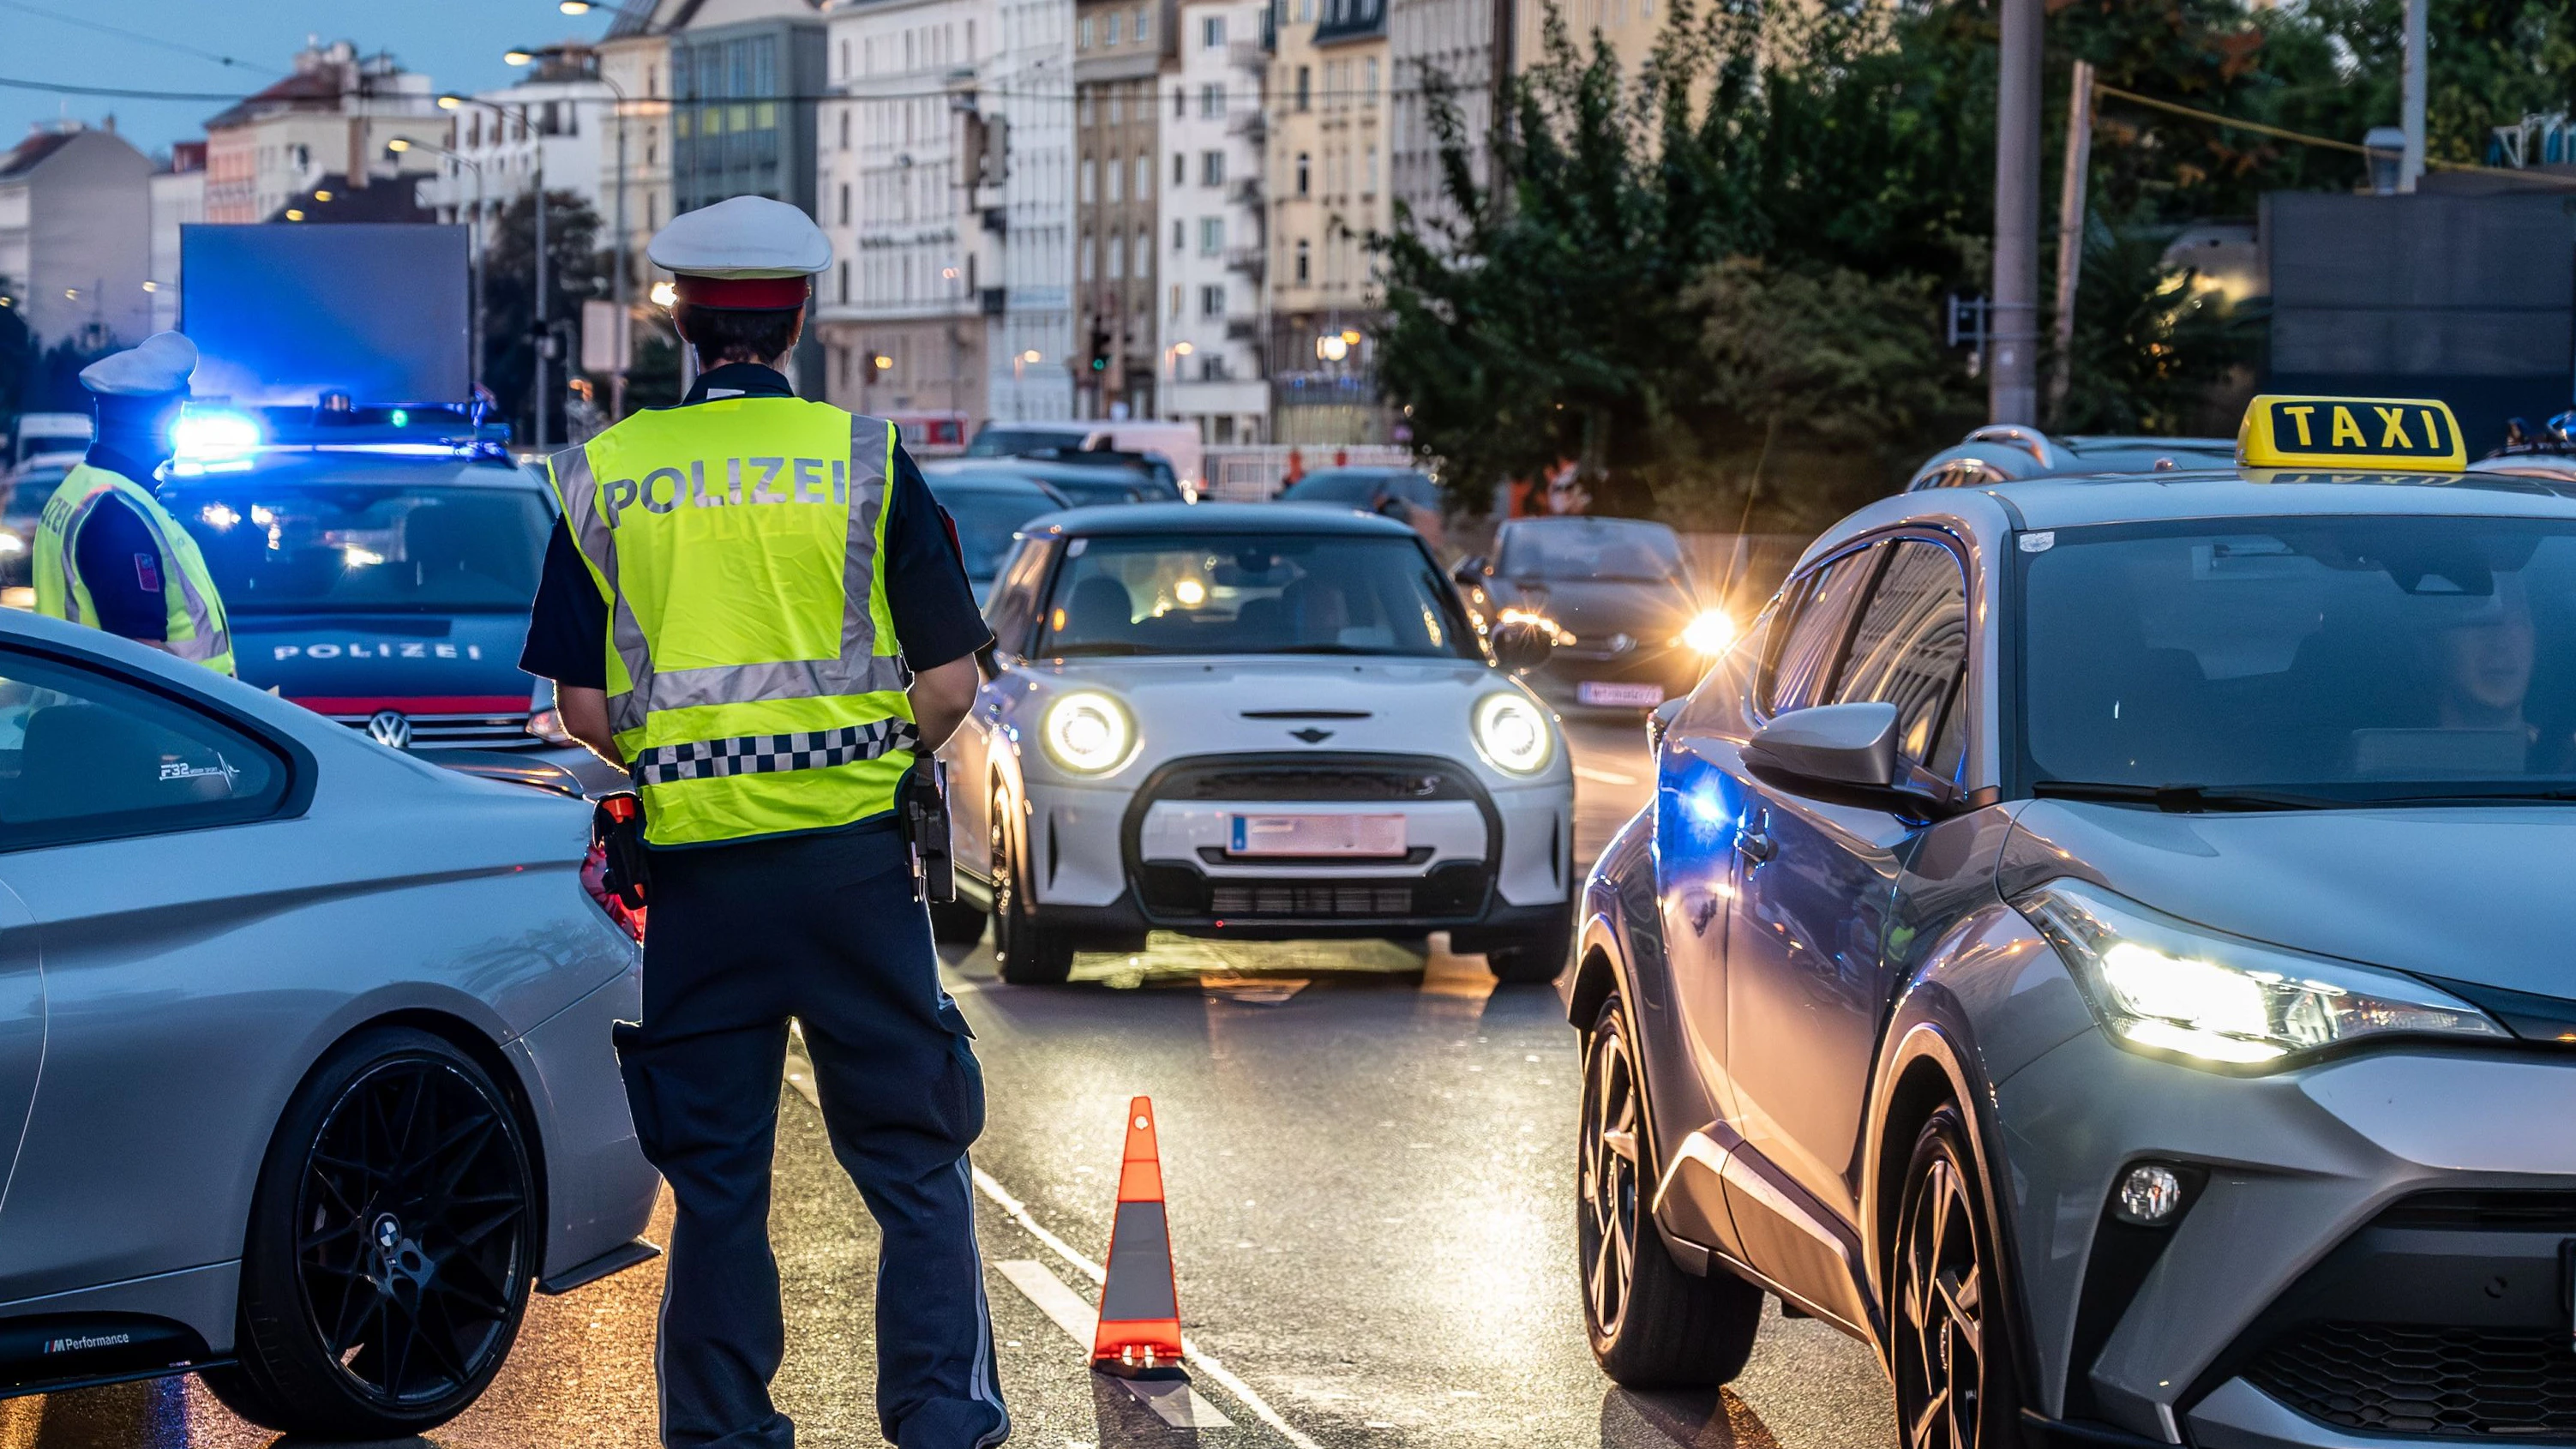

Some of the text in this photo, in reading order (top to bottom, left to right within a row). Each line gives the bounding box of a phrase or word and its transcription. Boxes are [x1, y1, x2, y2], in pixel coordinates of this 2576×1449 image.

[2284, 406, 2440, 449] TAXI
[603, 457, 846, 529] POLIZEI
[41, 496, 72, 535] IZEI
[273, 643, 482, 661] POLIZEI
[160, 762, 189, 777] F32
[65, 1332, 129, 1351] Performance
